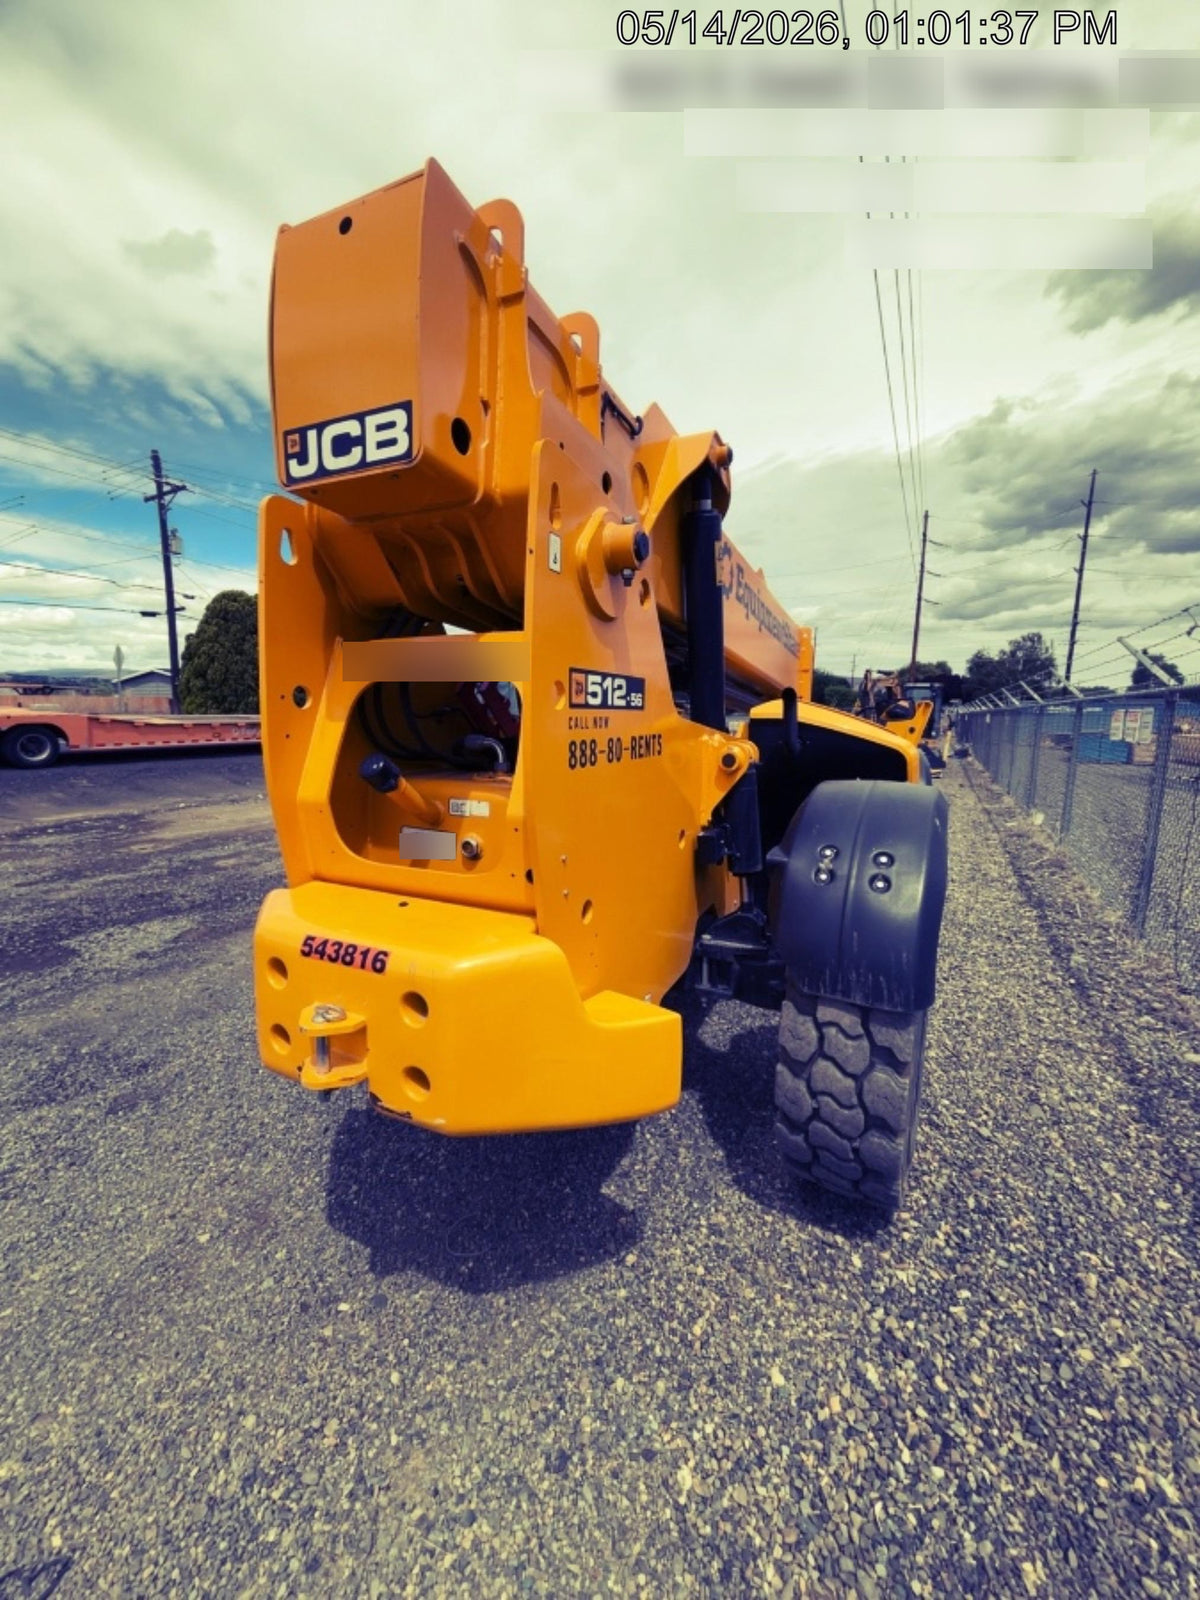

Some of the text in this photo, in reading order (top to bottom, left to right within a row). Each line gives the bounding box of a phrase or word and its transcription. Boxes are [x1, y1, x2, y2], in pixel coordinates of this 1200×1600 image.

[288, 408, 410, 478] JCB
[568, 716, 589, 730] CALL
[568, 733, 662, 770] 888-80-RENTS
[300, 934, 389, 974] 543816
